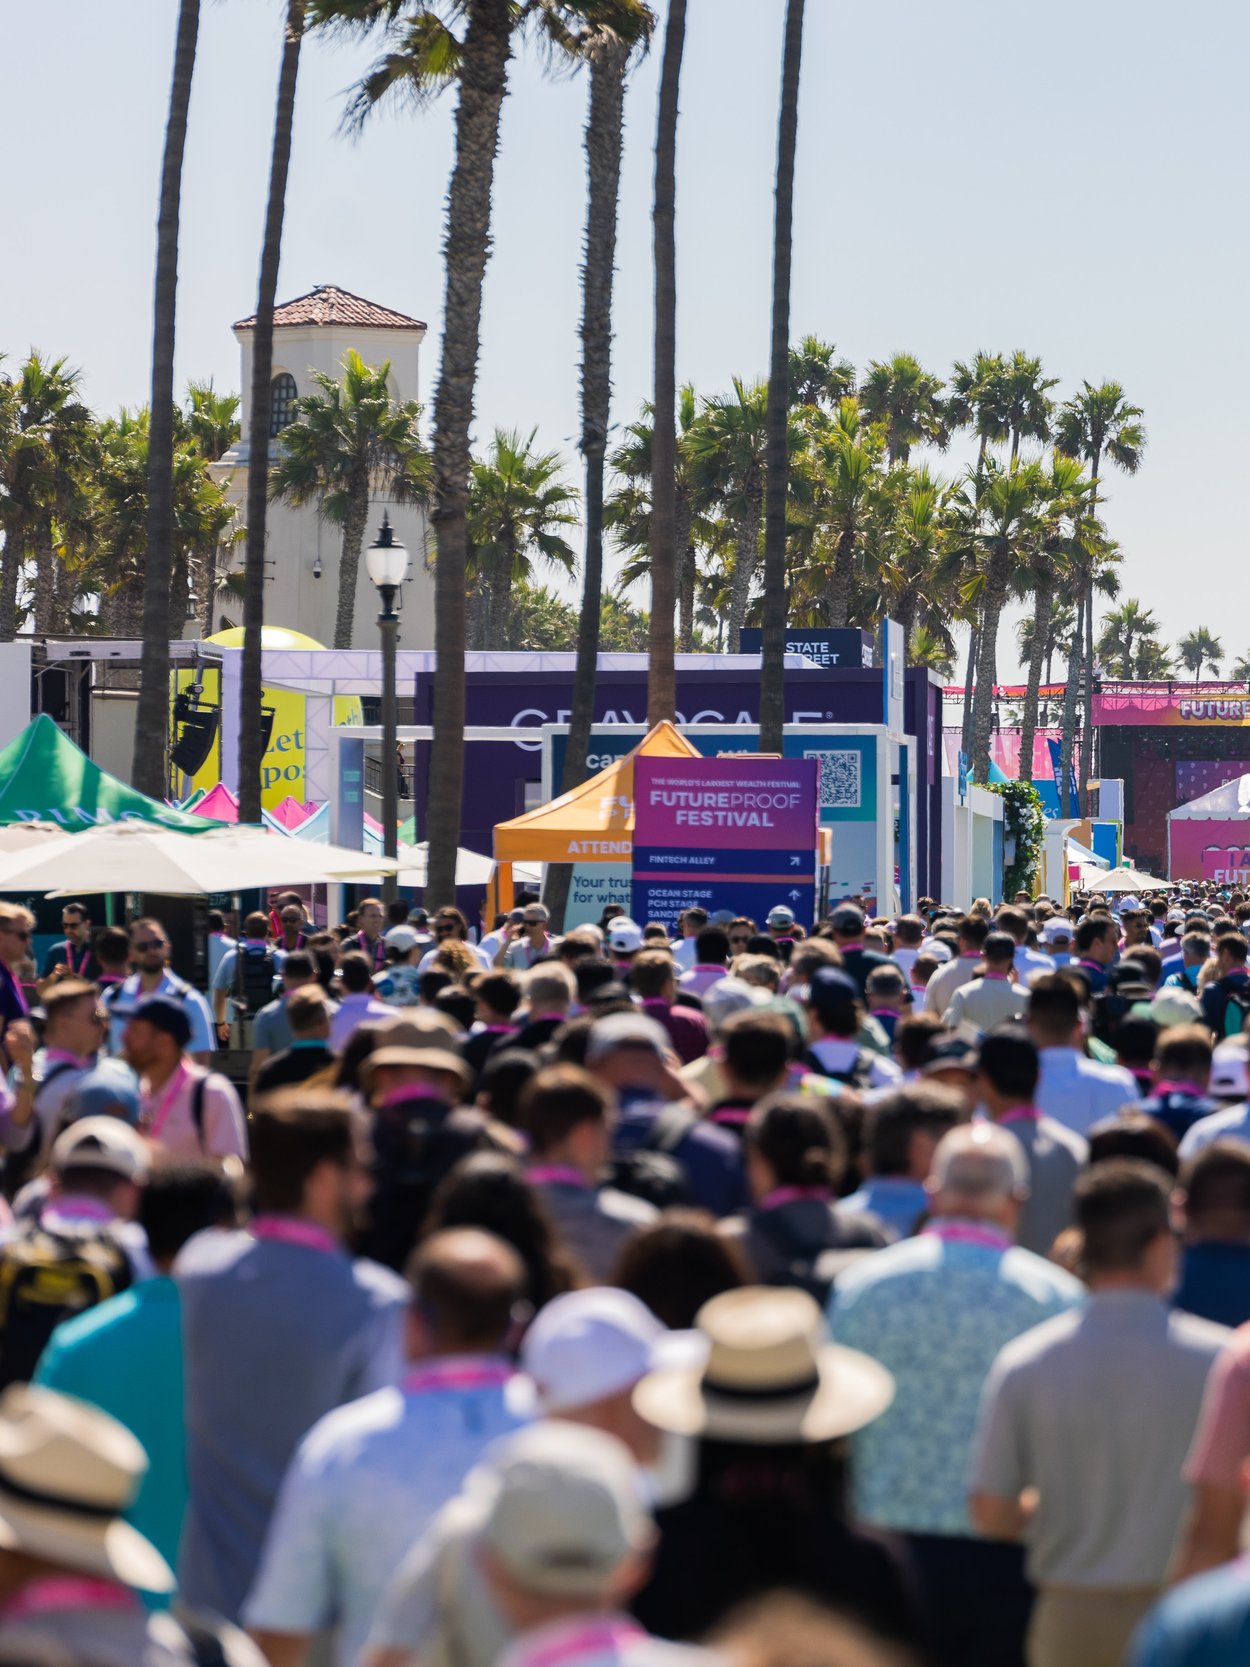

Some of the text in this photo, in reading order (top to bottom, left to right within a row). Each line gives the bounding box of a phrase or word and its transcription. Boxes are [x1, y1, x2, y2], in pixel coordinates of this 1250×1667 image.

[786, 641, 830, 654] STATE
[651, 777, 801, 789] THE WORLD'S LARGEST WEALTH FESTIVAL
[650, 789, 802, 810] FUTUREPROOF
[675, 810, 775, 827] FESTIVAL
[648, 855, 716, 865] FINTECH ALLEY
[1230, 853, 1235, 867] I
[573, 876, 605, 888] Your
[573, 891, 631, 904] for what
[647, 889, 713, 899] OCEAN STAGE
[647, 899, 699, 909] PCH STAGE
[647, 910, 680, 919] SANDB
